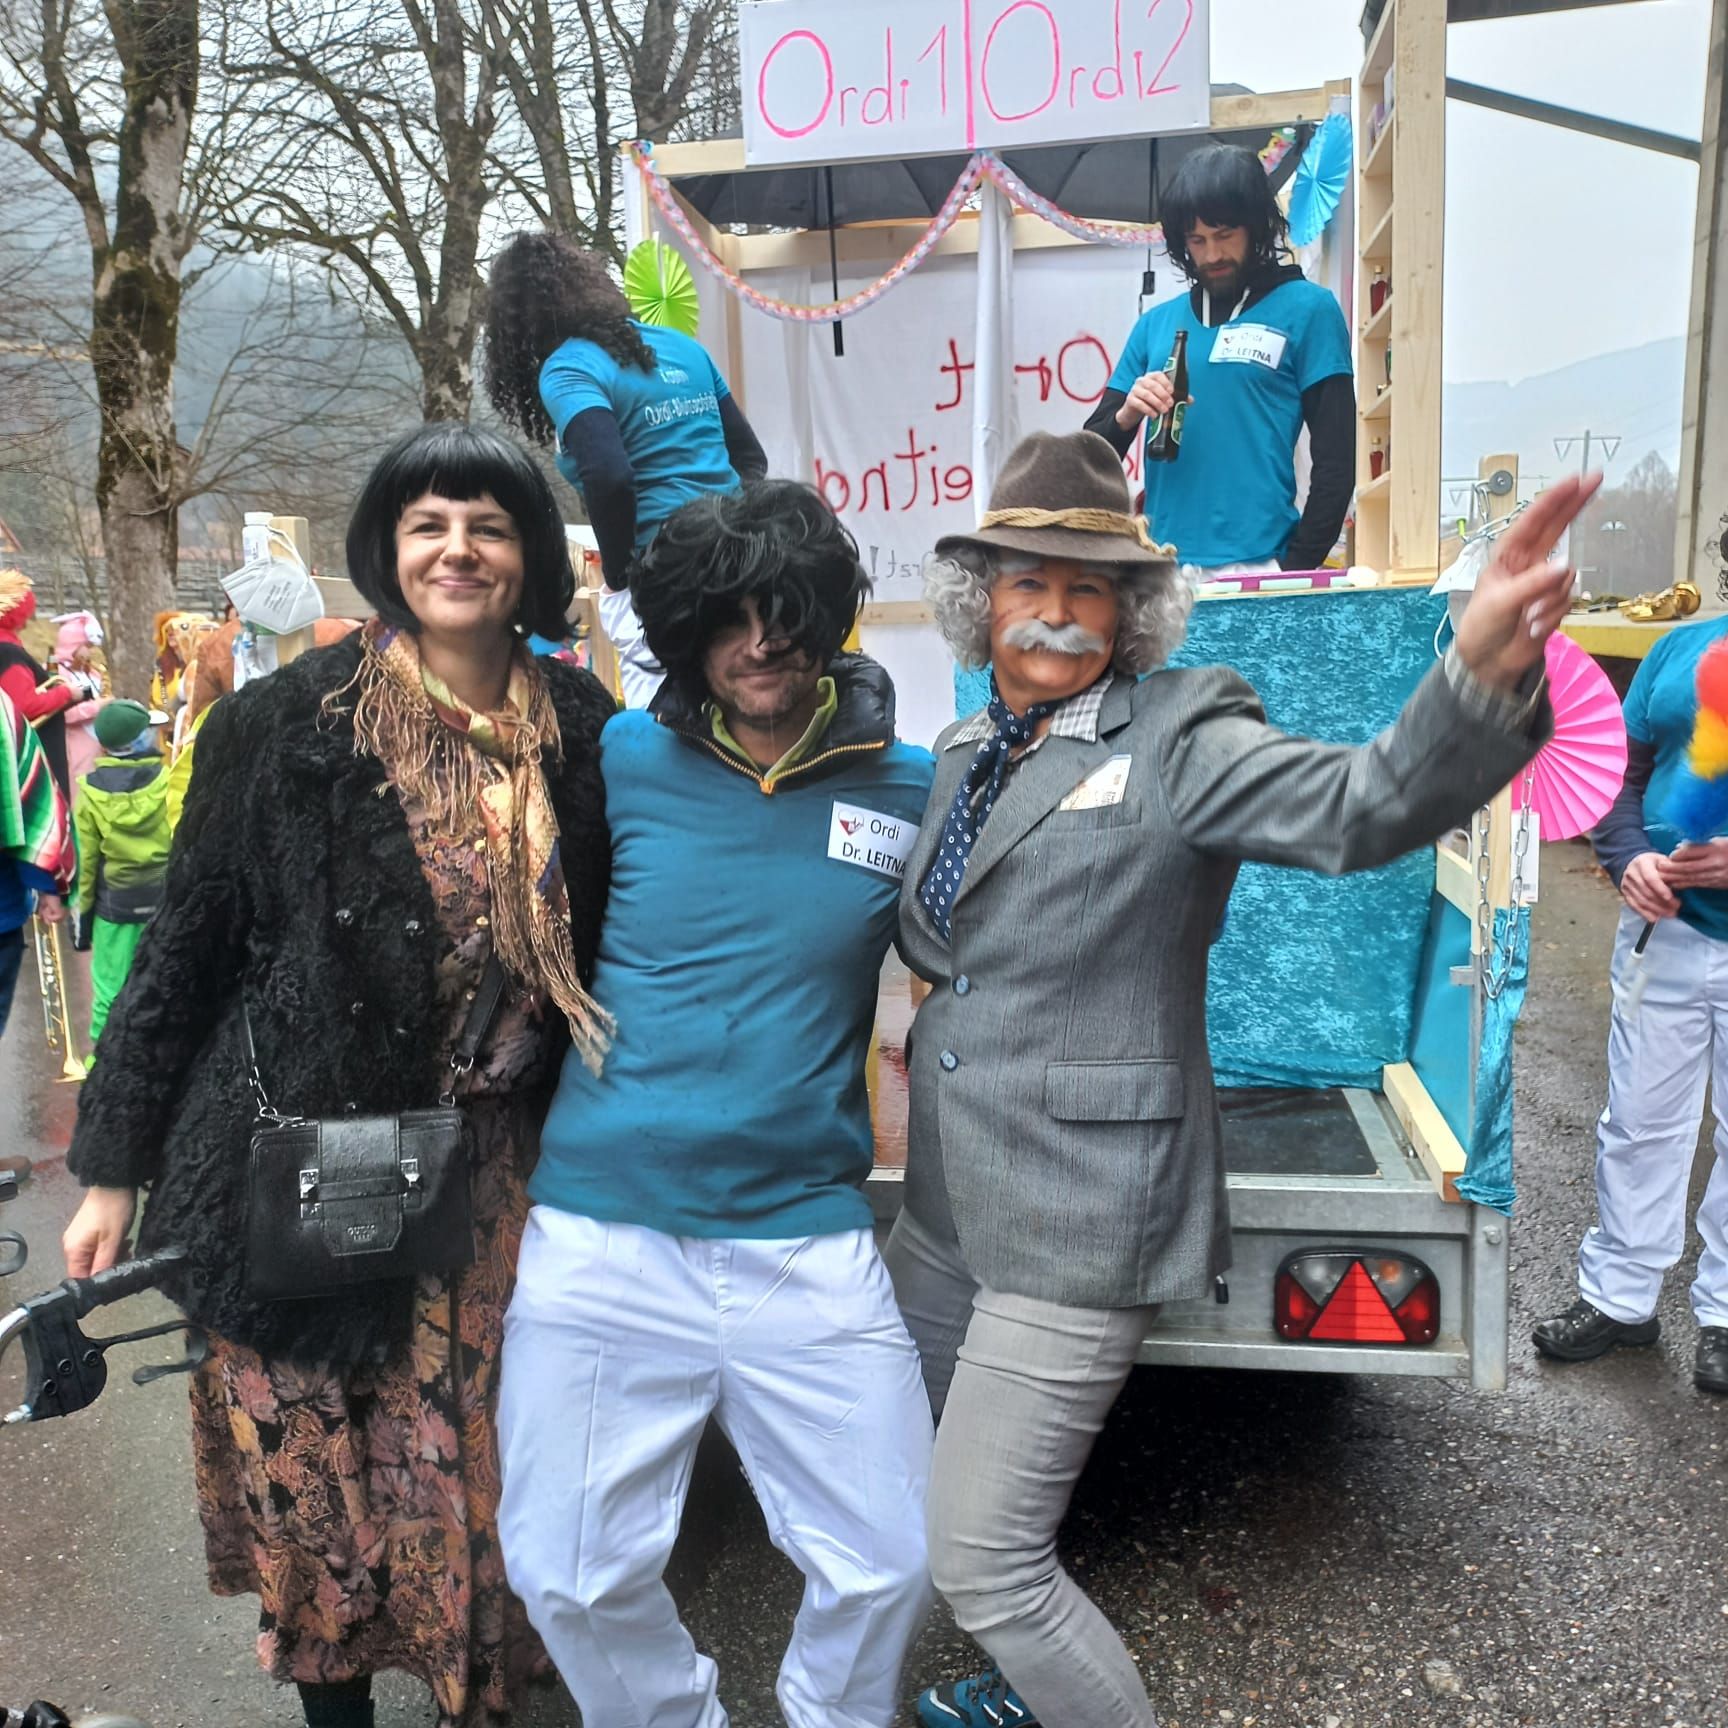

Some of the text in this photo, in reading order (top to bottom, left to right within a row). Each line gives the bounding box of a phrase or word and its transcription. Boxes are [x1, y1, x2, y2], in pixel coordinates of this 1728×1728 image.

[1237, 346, 1272, 364] LEITNA
[870, 818, 901, 841] Ordi
[842, 841, 861, 861] Dr.
